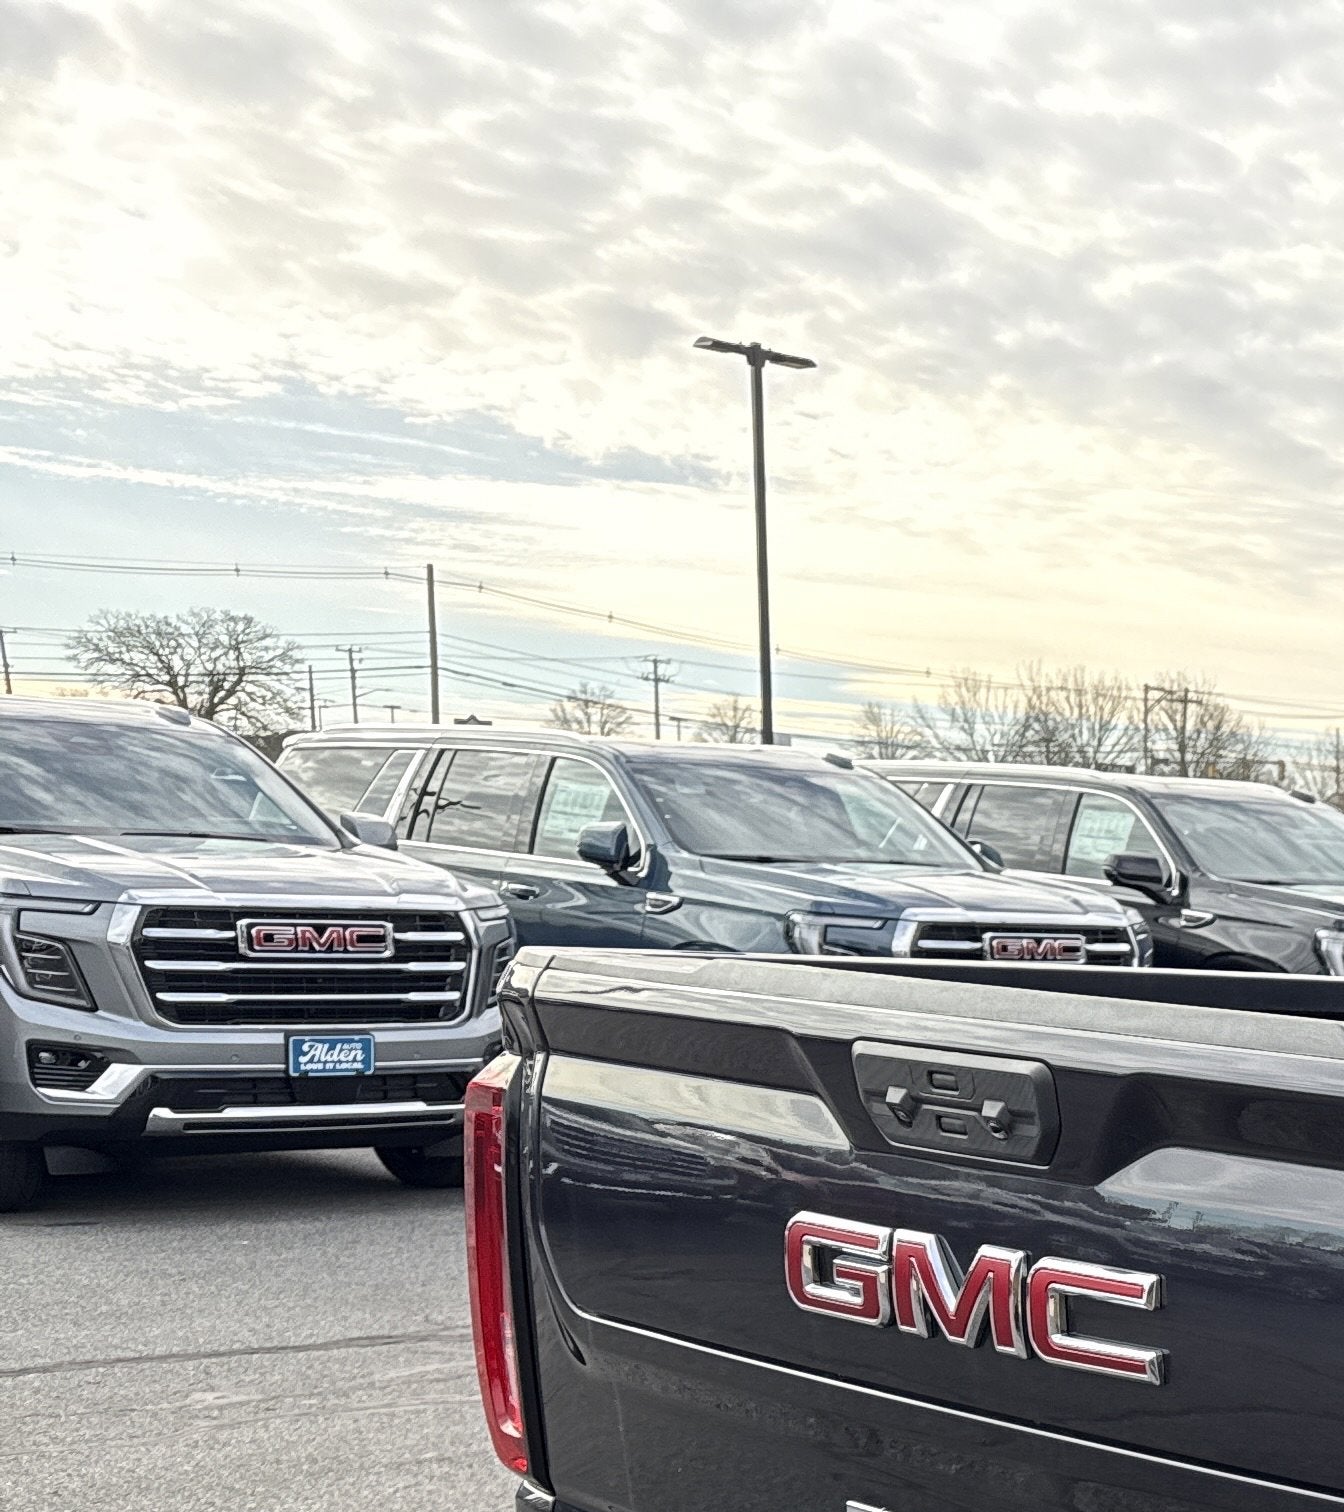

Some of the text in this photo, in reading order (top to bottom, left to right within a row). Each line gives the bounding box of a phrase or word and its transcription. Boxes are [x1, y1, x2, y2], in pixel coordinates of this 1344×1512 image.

[251, 926, 387, 951] GMC
[992, 938, 1082, 960] GMC
[298, 1041, 365, 1063] Alden
[784, 1210, 1169, 1386] GMC
